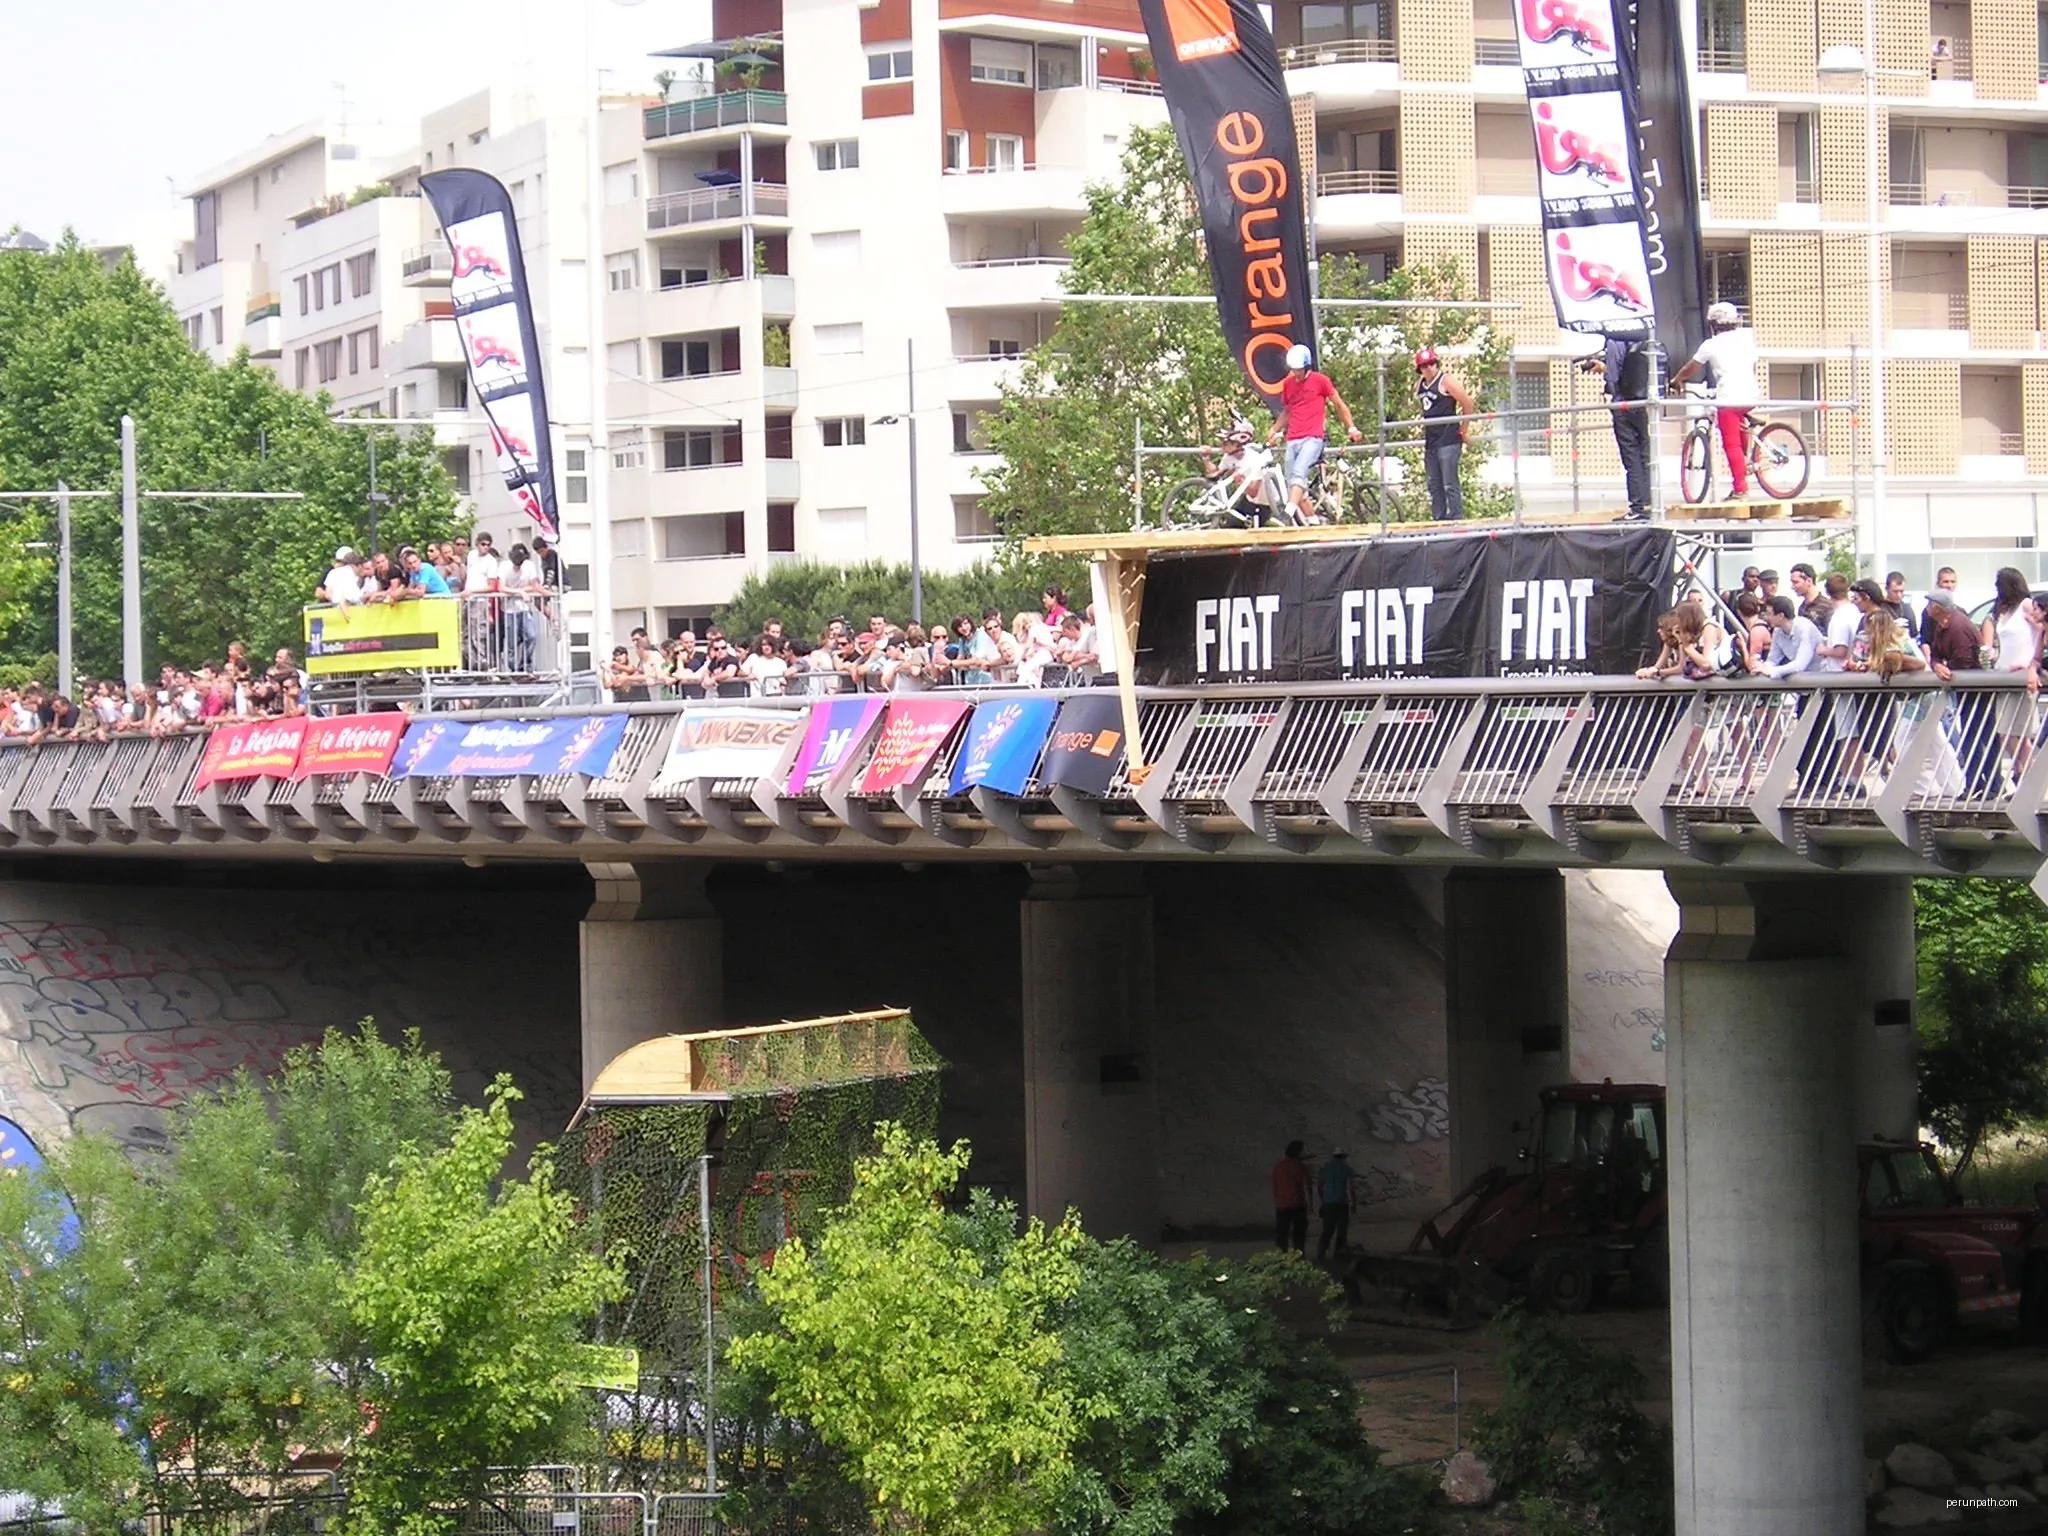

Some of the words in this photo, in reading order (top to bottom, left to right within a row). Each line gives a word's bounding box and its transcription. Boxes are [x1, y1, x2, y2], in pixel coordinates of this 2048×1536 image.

[1216, 111, 1293, 395] orange
[1196, 595, 1280, 673] FIAT
[1342, 586, 1434, 667] FIAT
[1502, 579, 1594, 661] FIAT
[335, 725, 392, 751] Région
